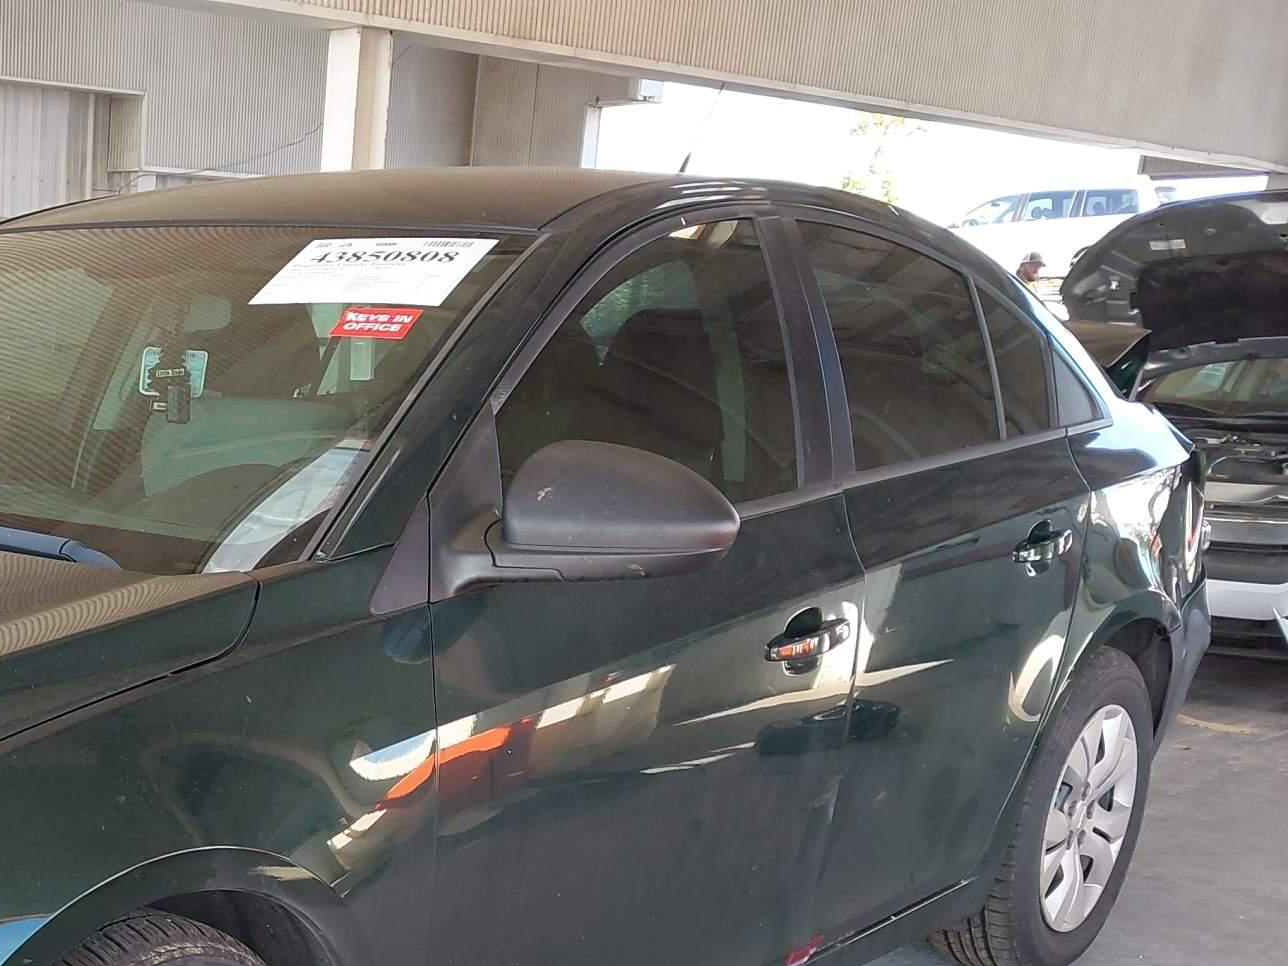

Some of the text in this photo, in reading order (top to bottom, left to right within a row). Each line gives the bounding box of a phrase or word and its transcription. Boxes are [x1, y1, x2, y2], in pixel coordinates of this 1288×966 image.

[310, 250, 459, 264] 43850808
[345, 311, 413, 323] KEYS IN
[343, 322, 402, 332] OFFICE
